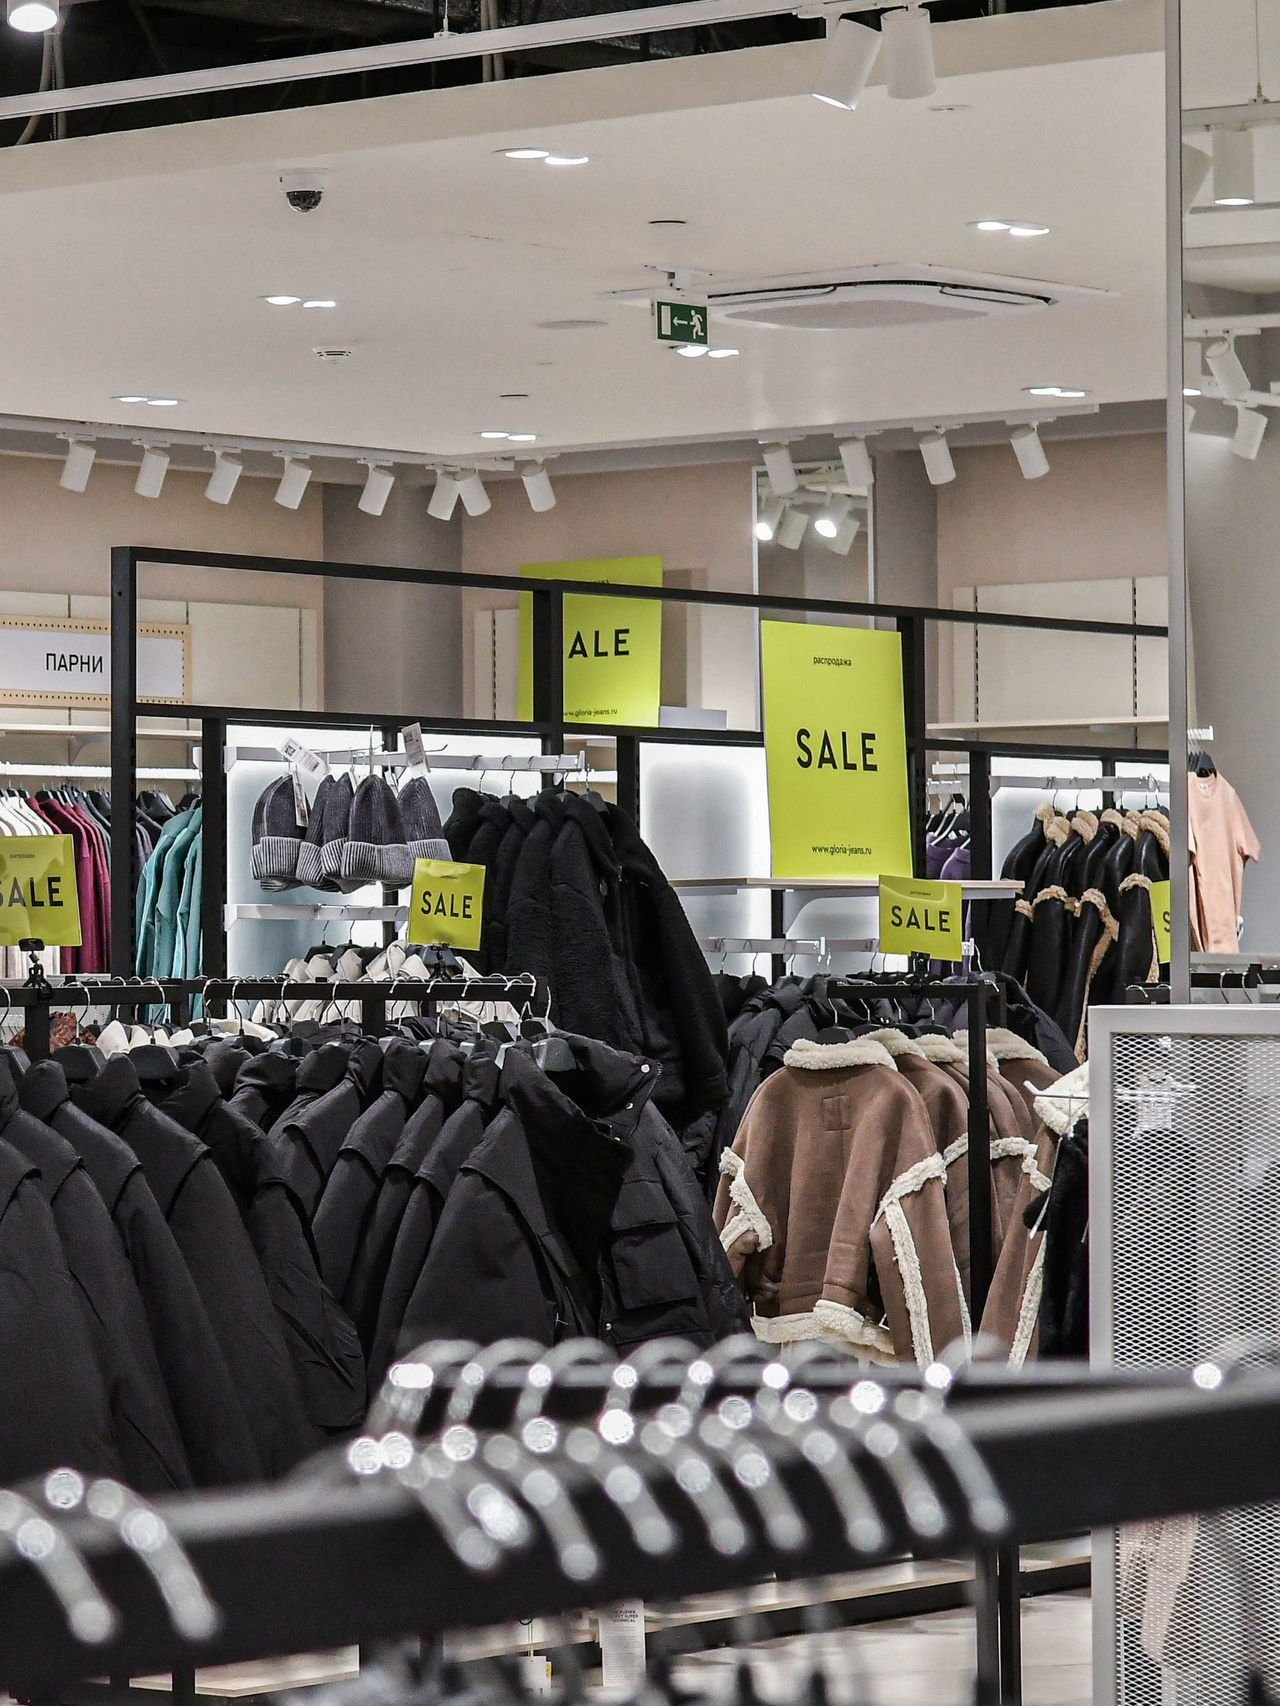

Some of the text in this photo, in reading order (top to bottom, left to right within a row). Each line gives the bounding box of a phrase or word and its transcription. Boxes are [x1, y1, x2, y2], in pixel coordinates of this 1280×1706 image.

[568, 629, 630, 659] ALE
[45, 652, 103, 674] ПАРНИ
[813, 656, 852, 667] распродажа
[796, 728, 878, 772] SALE
[811, 844, 872, 856] www.gloria-jeans.ru
[421, 890, 473, 919] SALE
[890, 905, 951, 933] SALE
